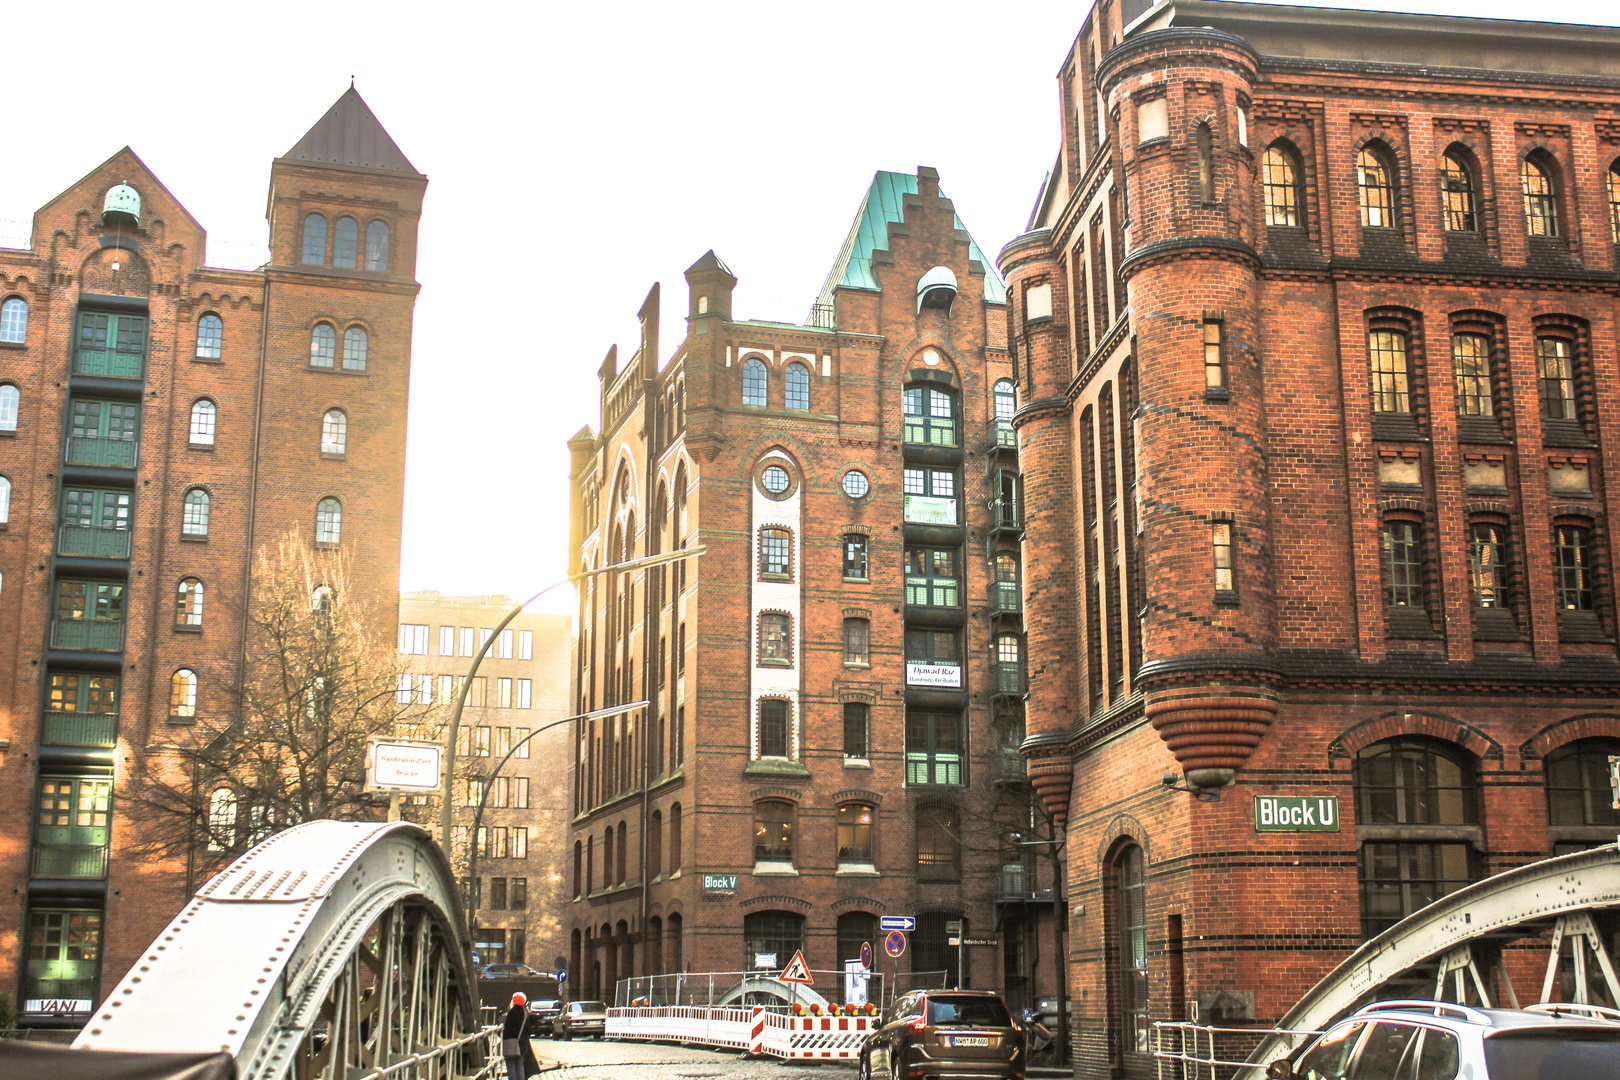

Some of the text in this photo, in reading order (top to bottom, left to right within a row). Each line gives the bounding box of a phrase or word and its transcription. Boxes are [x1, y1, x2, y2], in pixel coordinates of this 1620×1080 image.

[1260, 798, 1334, 826] Block U
[704, 875, 737, 889] Block V
